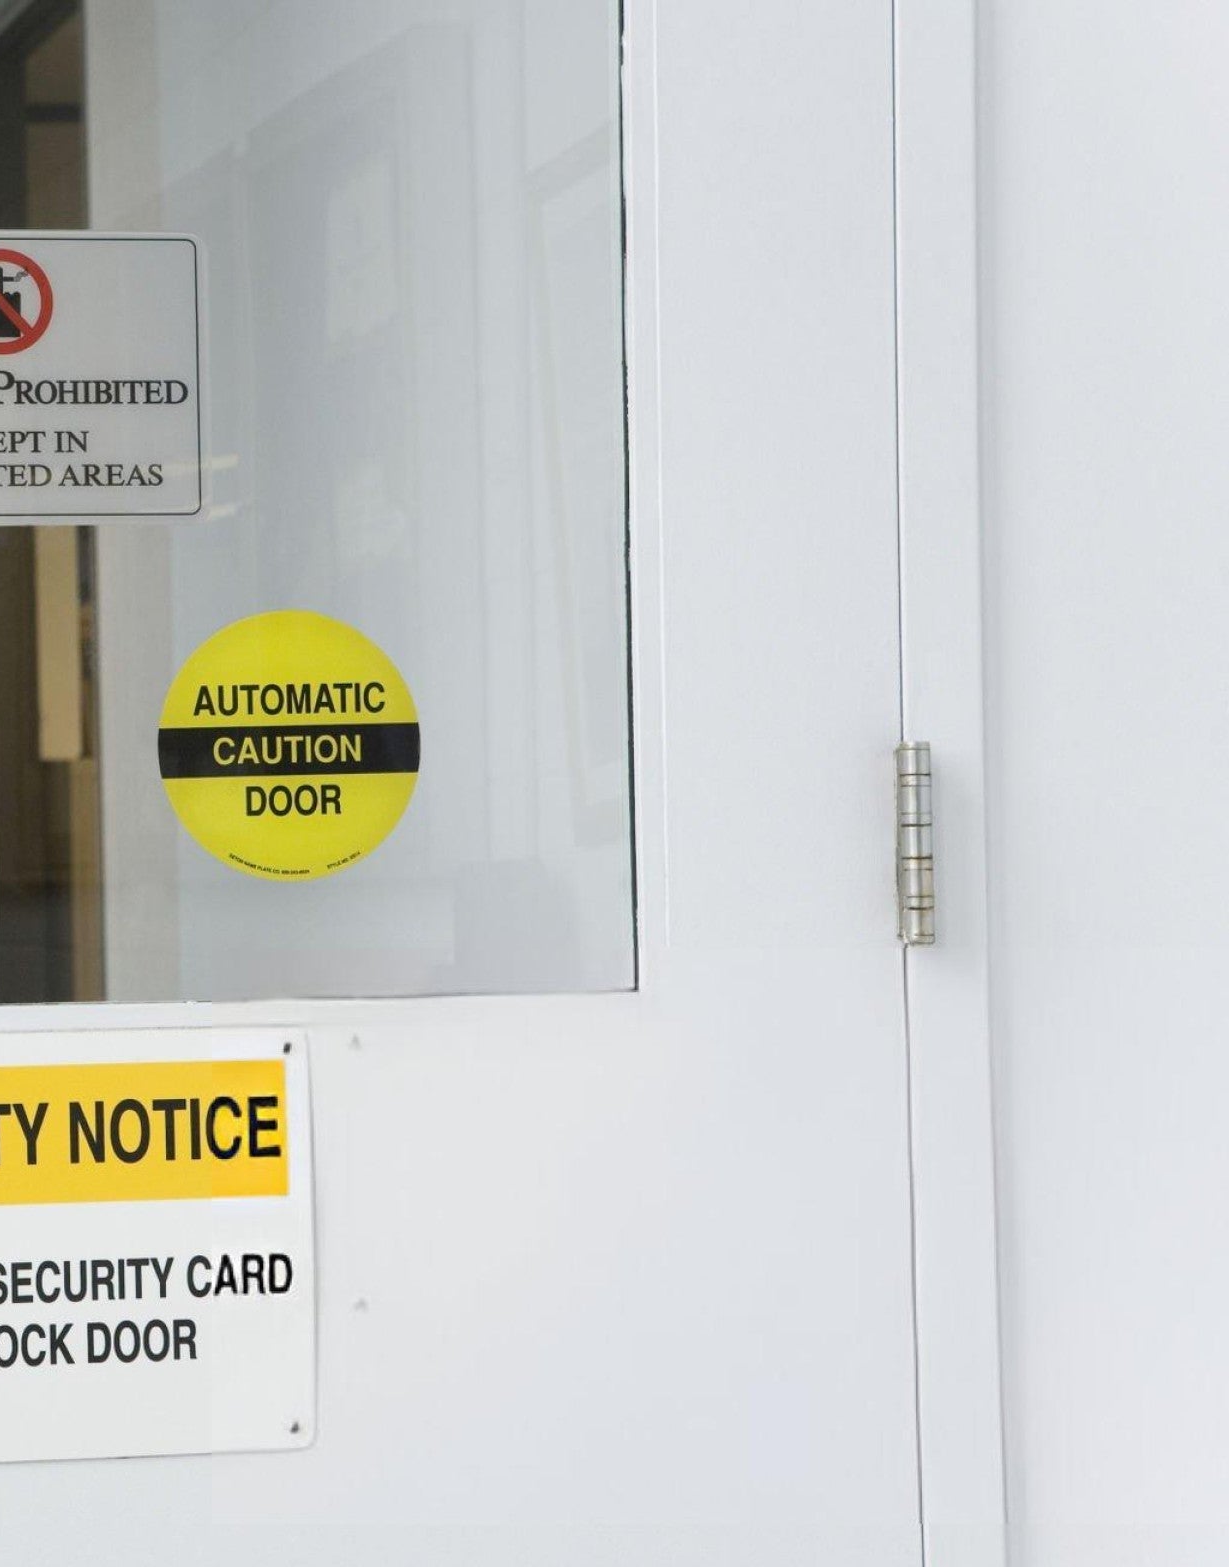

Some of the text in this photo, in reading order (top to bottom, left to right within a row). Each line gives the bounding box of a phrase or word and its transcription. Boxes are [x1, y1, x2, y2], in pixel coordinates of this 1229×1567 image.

[54, 430, 89, 453] IN
[58, 464, 163, 487] AREAS
[193, 682, 386, 717] AUTOMATIC
[212, 734, 362, 765] CAUTION
[245, 784, 342, 817] DOOR
[69, 1095, 282, 1164] NOTICE
[186, 1253, 293, 1298] CARD
[86, 1318, 198, 1364] DOOR
